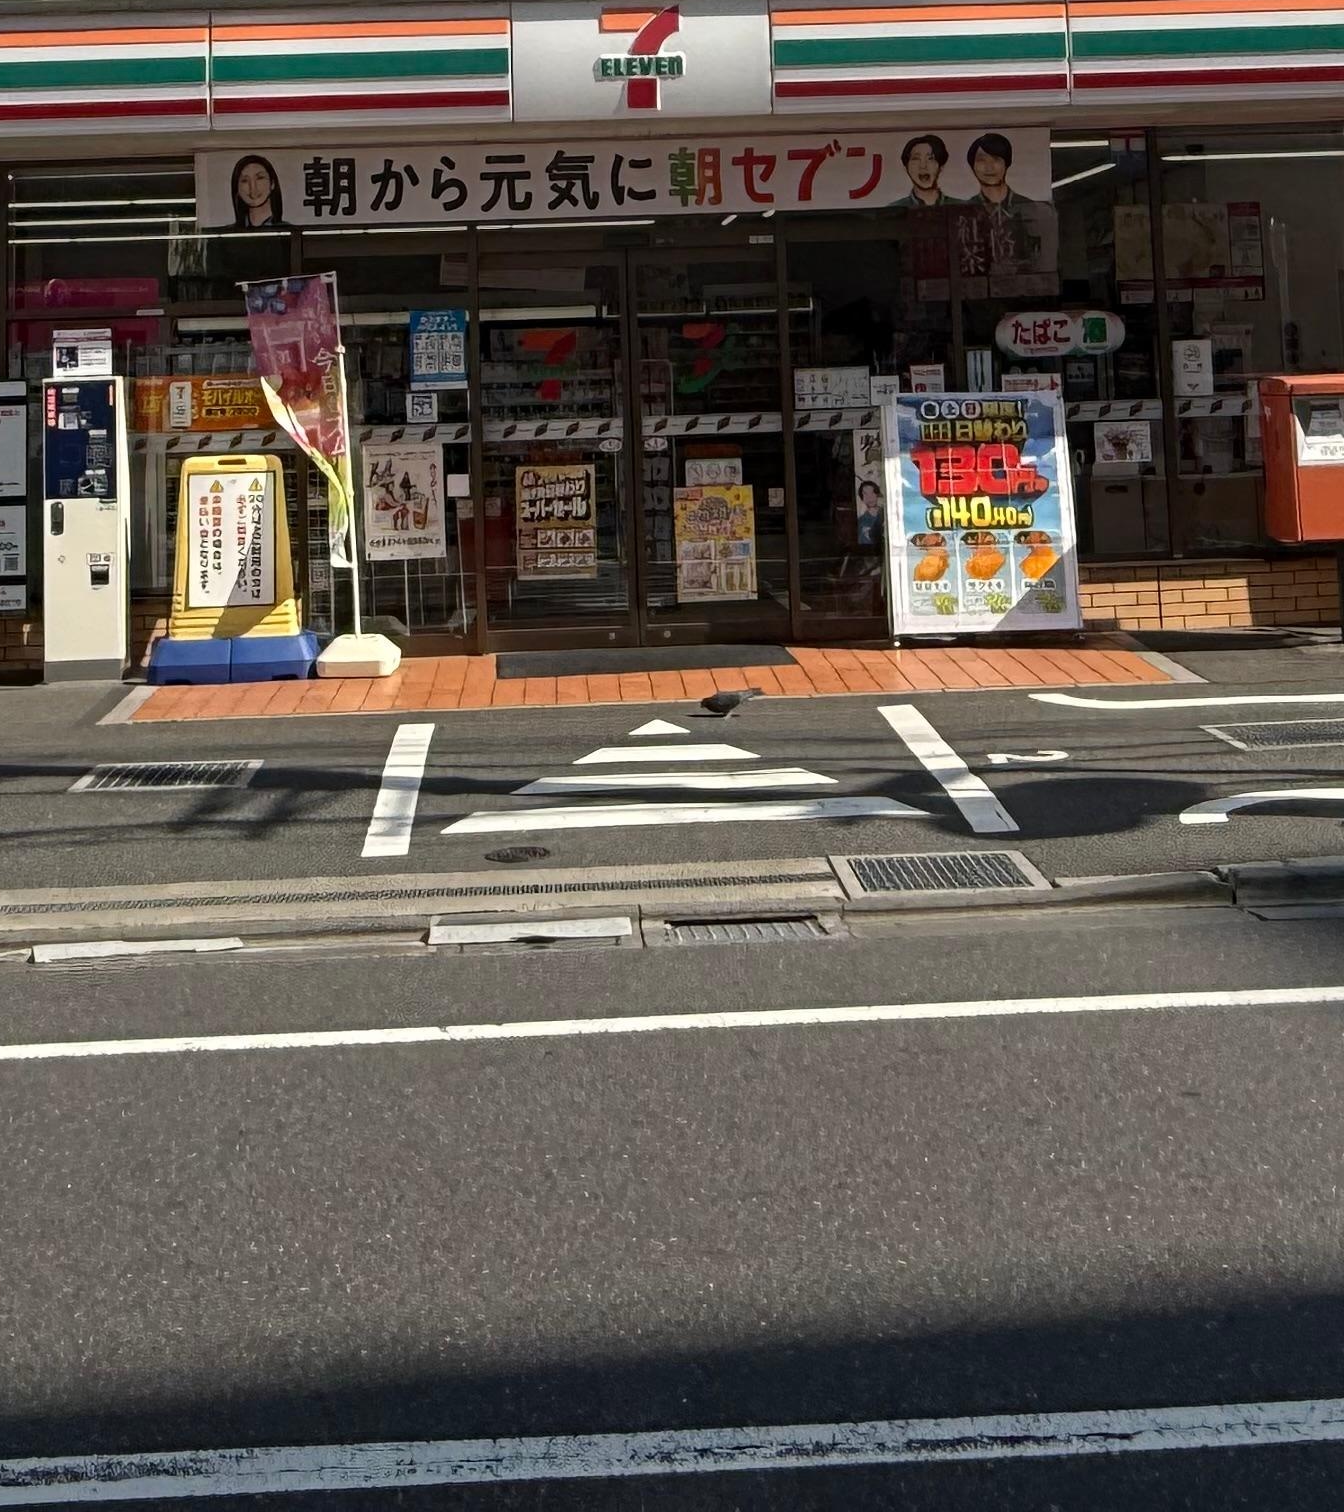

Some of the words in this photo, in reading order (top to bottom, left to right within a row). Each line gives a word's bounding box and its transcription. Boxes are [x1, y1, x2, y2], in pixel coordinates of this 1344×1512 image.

[302, 138, 884, 218] 朝から元気に朝セブン
[1012, 317, 1071, 345] たばこ
